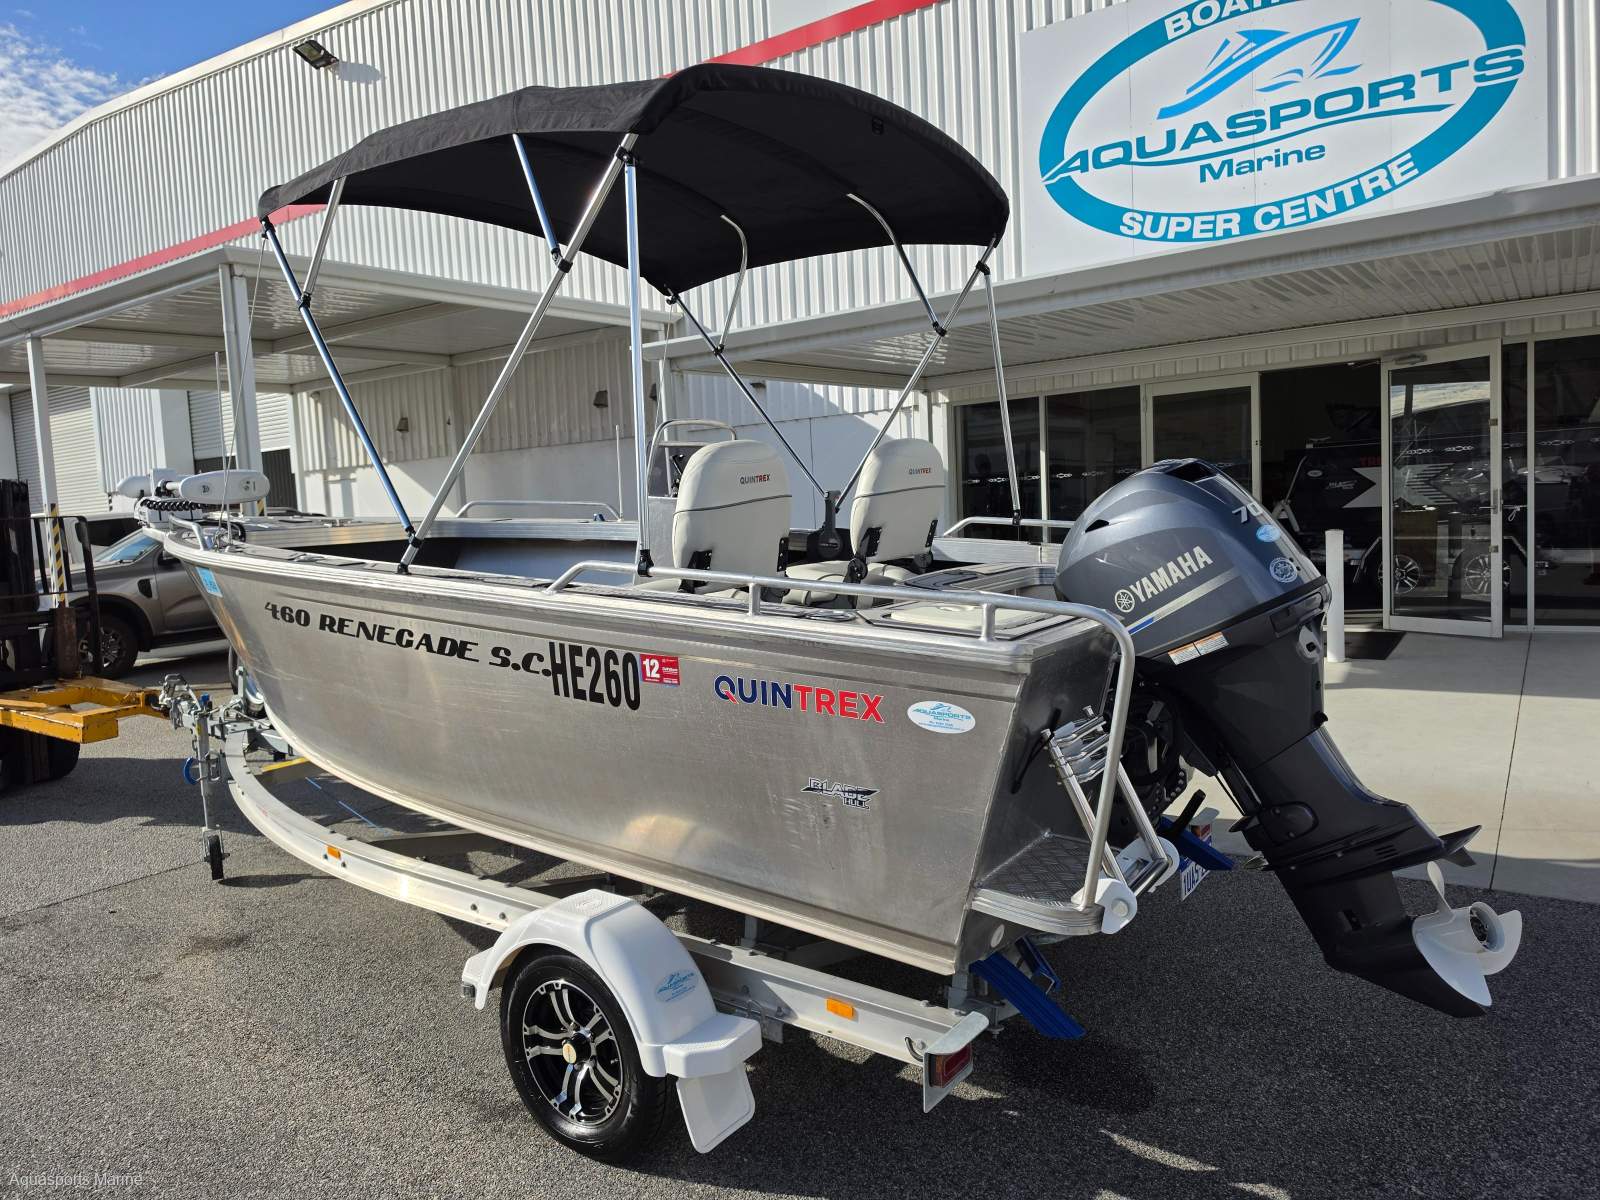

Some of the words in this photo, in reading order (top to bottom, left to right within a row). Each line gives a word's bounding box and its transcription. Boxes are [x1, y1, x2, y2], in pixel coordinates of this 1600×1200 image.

[1043, 45, 1525, 184] AQUASPORTS
[1199, 142, 1326, 184] Marine
[1119, 211, 1240, 240] SUPER
[1252, 152, 1420, 234] CENTRE
[740, 473, 771, 485] QUINTREX
[1129, 546, 1214, 603] YAMAHA
[264, 602, 311, 627] 460
[319, 614, 480, 662] RENEGADE
[548, 641, 641, 711] HE260
[642, 658, 660, 679] 12
[713, 674, 886, 724] QUINTREX
